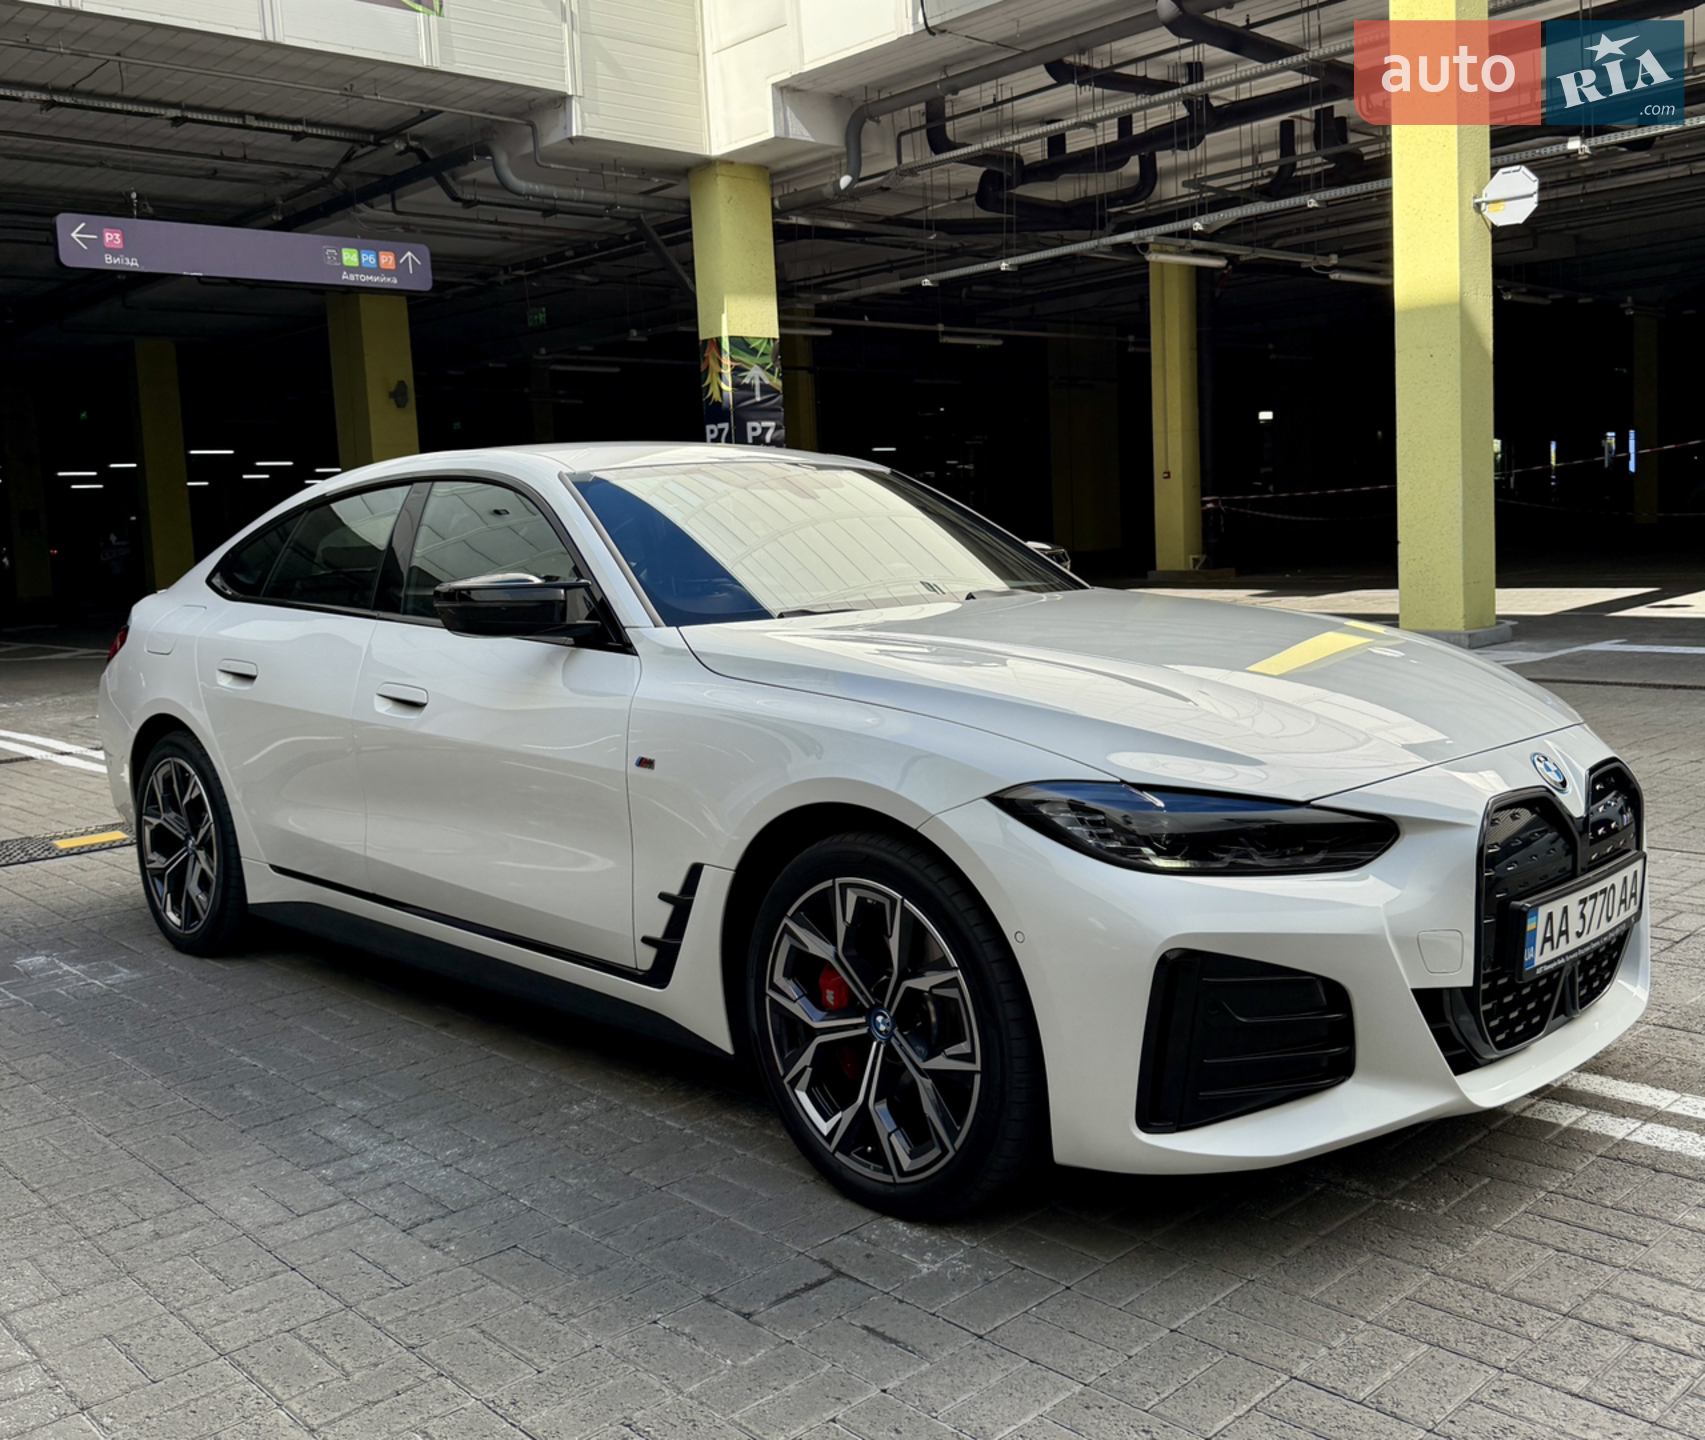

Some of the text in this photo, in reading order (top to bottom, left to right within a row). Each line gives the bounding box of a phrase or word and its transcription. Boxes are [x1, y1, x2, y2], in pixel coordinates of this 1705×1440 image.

[105, 232, 121, 245] P3
[104, 253, 139, 267] Виїзд
[342, 252, 394, 266] P4 P6 P7
[341, 270, 398, 284] Автомийка
[705, 422, 729, 443] P7
[746, 421, 776, 443] P7
[1539, 904, 1570, 957] AA
[1575, 882, 1616, 939] 3770
[1617, 868, 1638, 918] AA
[1524, 946, 1534, 962] UA
